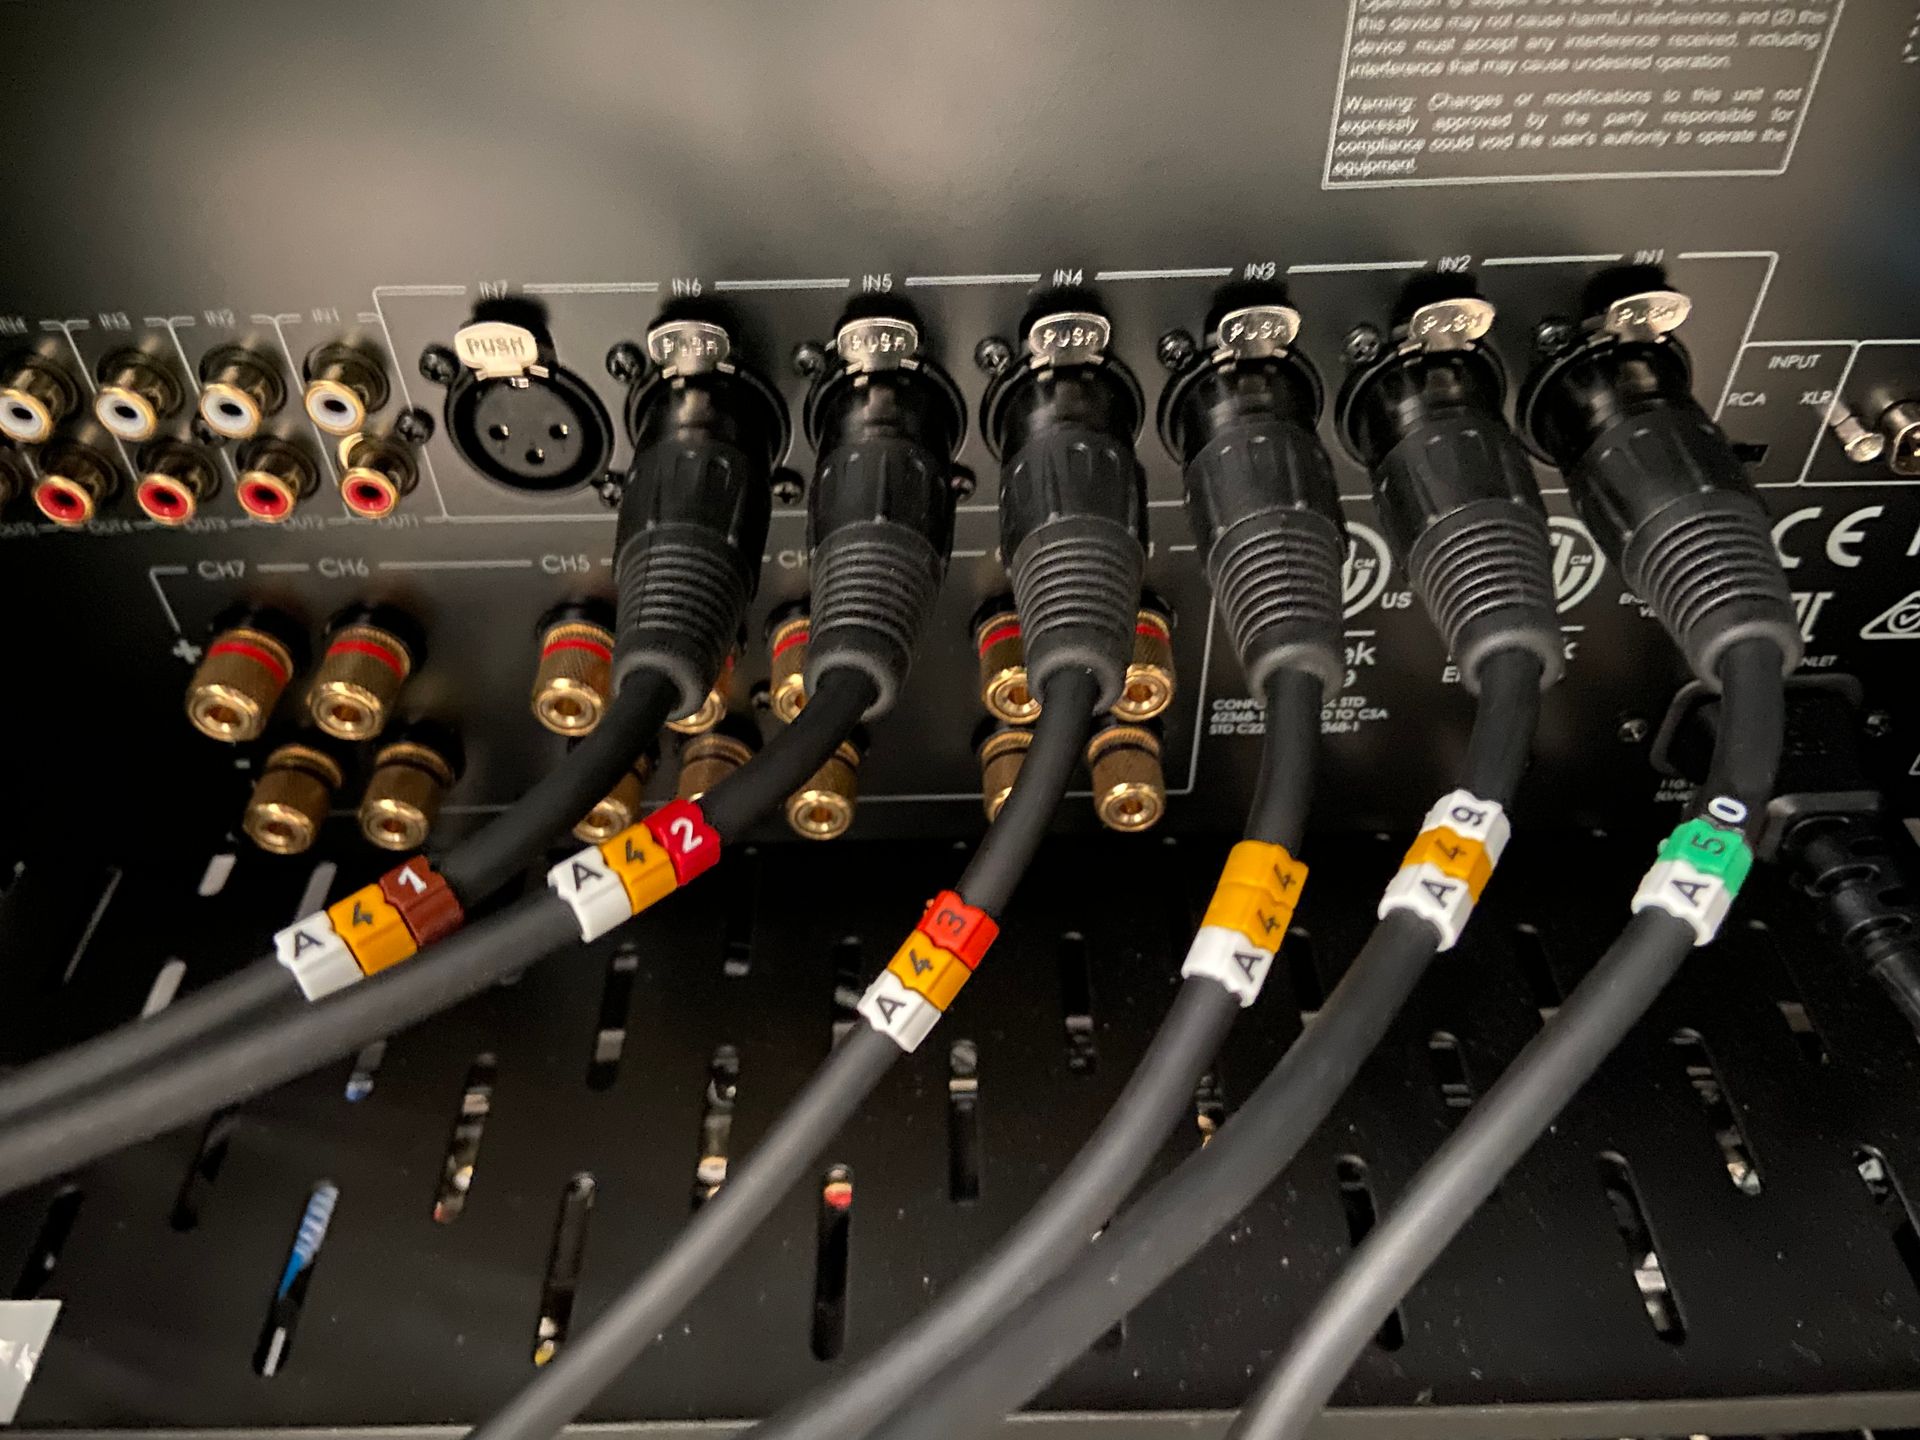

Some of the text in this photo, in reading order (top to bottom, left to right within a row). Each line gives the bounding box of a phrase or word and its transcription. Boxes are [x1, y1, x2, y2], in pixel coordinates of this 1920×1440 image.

[1515, 14, 1566, 28] cause
[1737, 9, 1771, 25] and
[1771, 8, 1796, 27] (2)
[1524, 37, 1558, 54] any
[1563, 33, 1661, 50] interference
[1748, 31, 1822, 50] including
[1349, 60, 1446, 79] interference
[1518, 58, 1570, 73] cause
[1572, 54, 1653, 72] undesired
[1427, 92, 1504, 112] Changes
[1513, 92, 1535, 107] or
[1542, 88, 1652, 107] modifications
[1662, 88, 1681, 104] to
[1774, 87, 1803, 102] not
[1337, 115, 1420, 136] expressly
[1431, 112, 1513, 134] approved
[1524, 111, 1549, 131] by
[1603, 110, 1649, 129] party
[1661, 107, 1758, 126] responsible
[1771, 106, 1796, 123] for
[1334, 137, 1426, 159] compliance
[1428, 134, 1476, 152] could
[1478, 132, 1515, 151] void
[1517, 132, 1546, 149] the
[1600, 128, 1672, 148] authority
[1674, 129, 1693, 145] to
[1696, 129, 1758, 147] operate
[1760, 127, 1788, 143] the
[1437, 254, 1471, 273] IN2
[1633, 248, 1664, 265] IN1
[1052, 268, 1083, 288] IN4
[1244, 261, 1276, 280] IN3
[479, 280, 508, 299] IN7
[672, 277, 702, 297] IN6
[862, 273, 893, 293] IN5
[464, 336, 525, 357] PUSH
[1768, 354, 1821, 370] INPUT
[1726, 391, 1766, 406] RCA
[1799, 390, 1833, 405] XLR
[318, 557, 370, 578] CH6
[541, 555, 590, 574] CH5
[1570, 554, 1593, 565] CM
[198, 560, 245, 580] CH7
[1381, 592, 1412, 609] US
[1801, 655, 1837, 668] NLET
[1358, 708, 1389, 720] CSA
[572, 817, 703, 891] A42
[1673, 797, 1747, 907] A50
[294, 866, 427, 958] A41
[1233, 864, 1296, 982] A44
[875, 910, 965, 1024] A43
